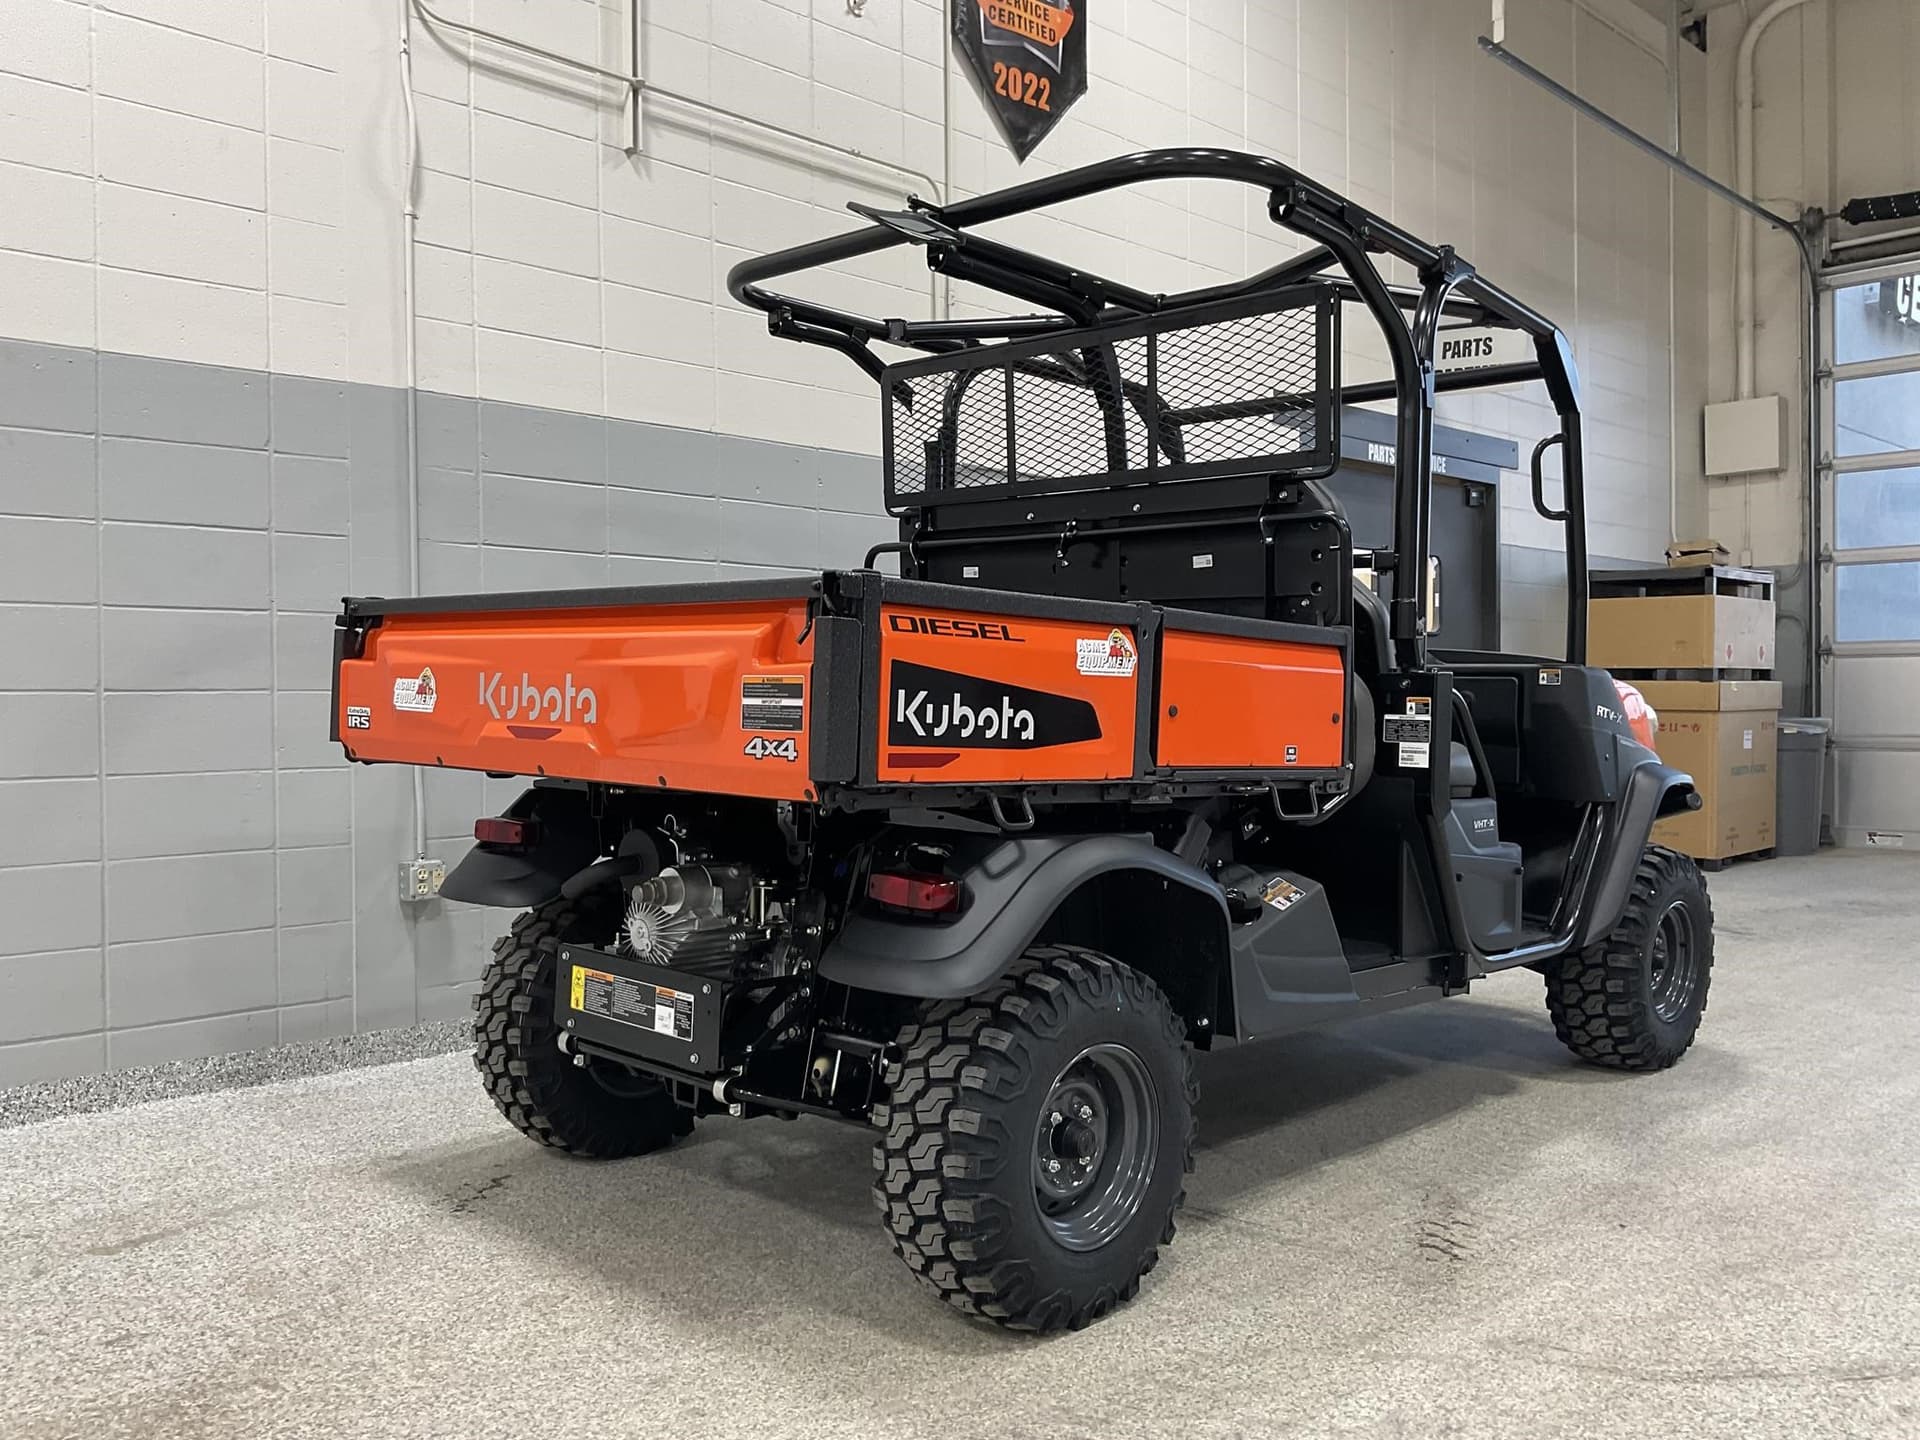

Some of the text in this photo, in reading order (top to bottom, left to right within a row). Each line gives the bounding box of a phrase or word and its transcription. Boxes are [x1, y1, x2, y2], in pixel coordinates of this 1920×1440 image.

[989, 5, 1056, 42] CERTIFIED
[998, 0, 1050, 22] RVICE
[993, 61, 1051, 112] 2022
[1441, 337, 1493, 360] PARTS
[1368, 443, 1395, 464] PARTS
[888, 615, 1026, 642] DIESEL
[1078, 655, 1136, 670] EQUIPMENT
[478, 671, 597, 725] Kubota
[348, 716, 369, 728] IRS
[896, 688, 1034, 741] Kubota
[744, 736, 798, 761] 4x4
